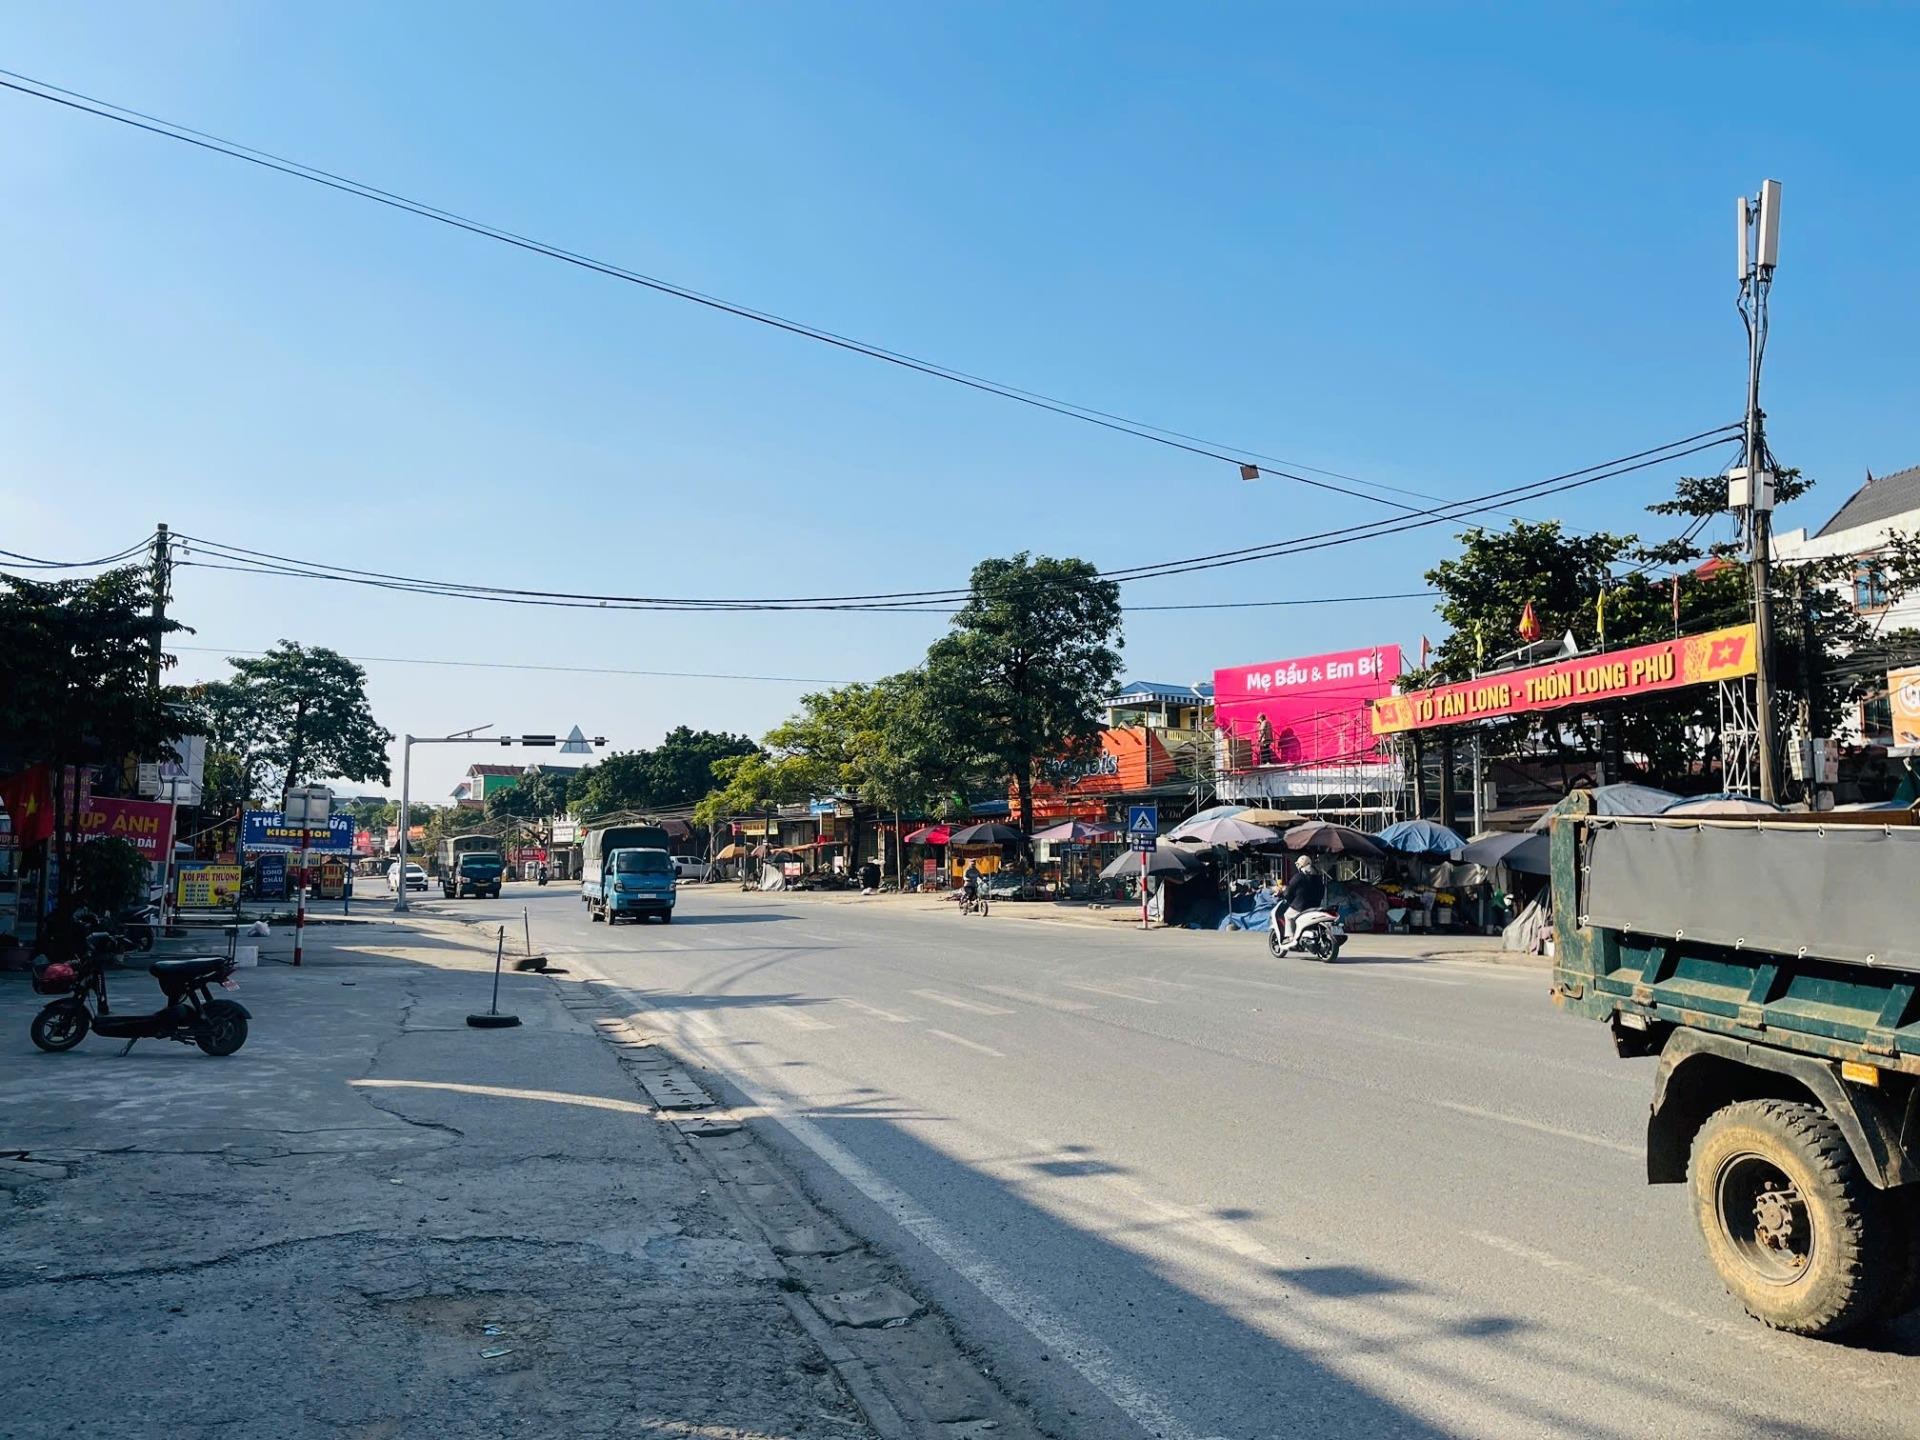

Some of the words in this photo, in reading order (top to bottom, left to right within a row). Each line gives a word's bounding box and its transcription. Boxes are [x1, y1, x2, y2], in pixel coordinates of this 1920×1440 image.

[1246, 671, 1271, 692] Mẹ
[1311, 667, 1323, 681] &
[1326, 661, 1354, 680] Em
[1415, 690, 1434, 722] TỔ
[1468, 683, 1512, 713] LONG
[1525, 669, 1574, 704] THÔN
[1576, 661, 1627, 695] LONG
[1631, 646, 1676, 686] PHÚ
[112, 809, 159, 833] ẢNH
[329, 817, 348, 831] ỮA
